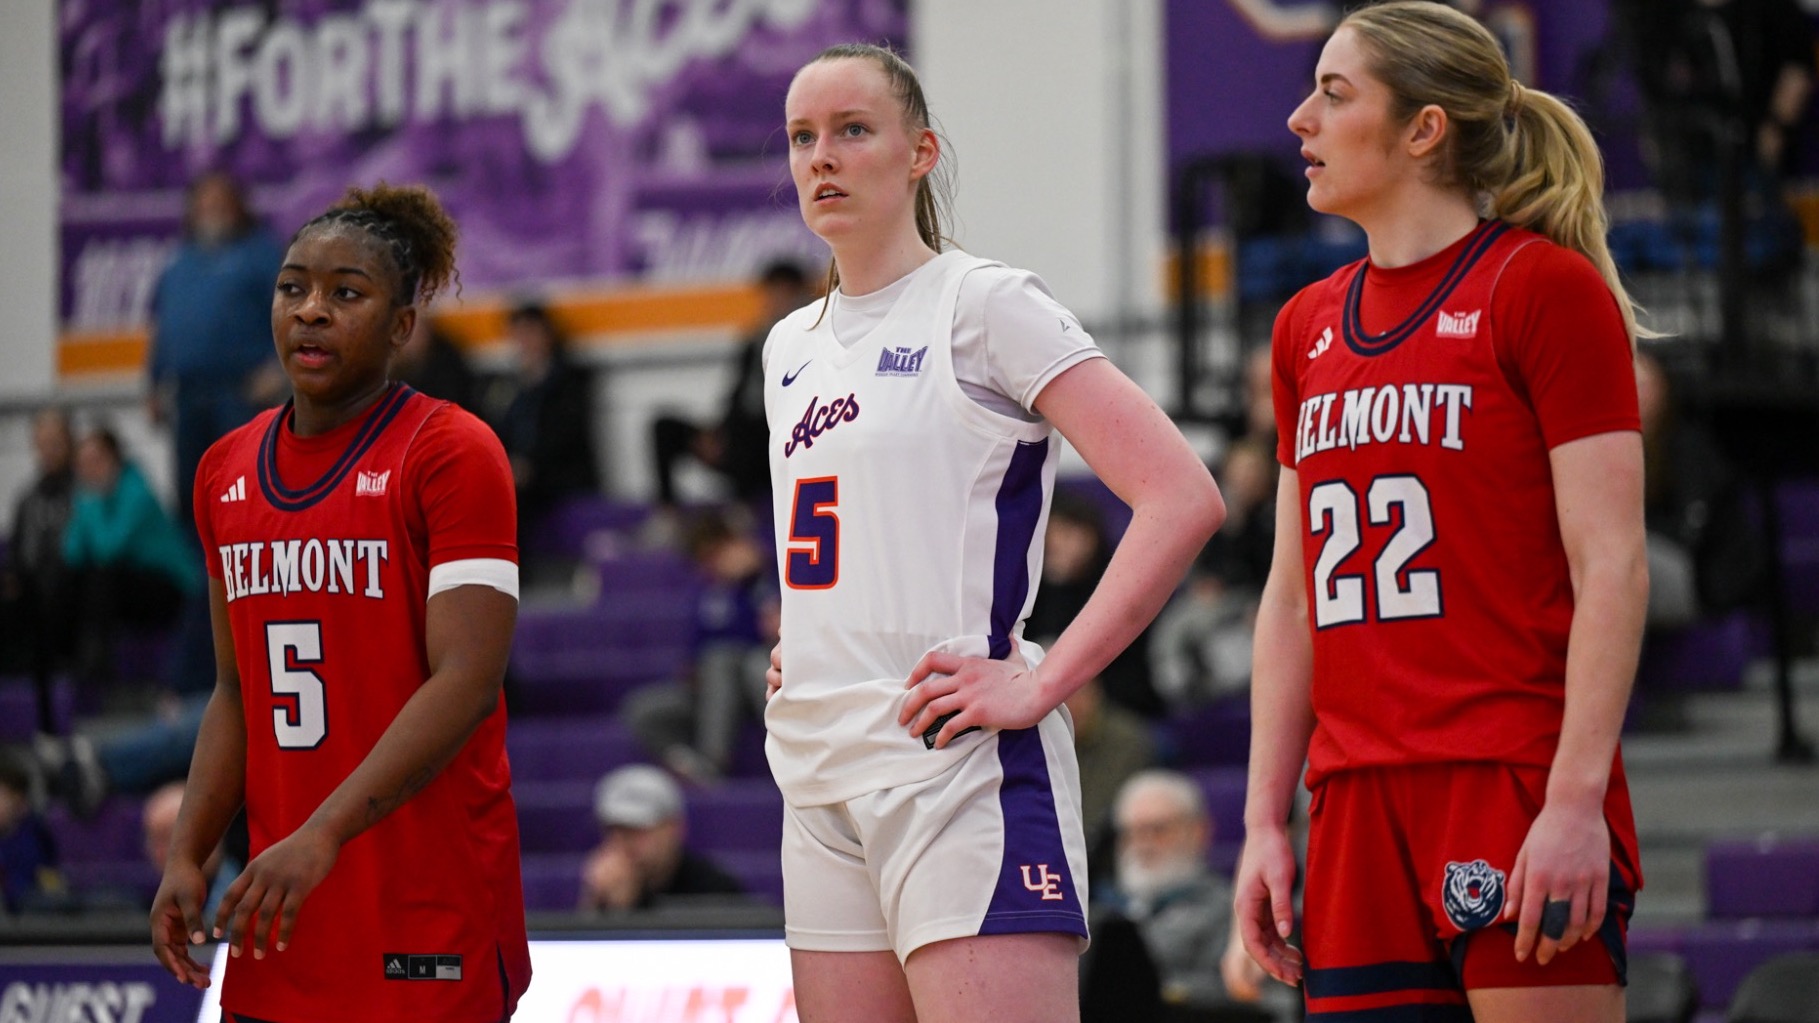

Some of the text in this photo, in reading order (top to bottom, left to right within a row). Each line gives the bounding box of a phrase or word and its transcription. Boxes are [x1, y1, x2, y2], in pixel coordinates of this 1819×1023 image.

[1437, 309, 1482, 334] VALLEY
[877, 345, 928, 372] VALLEY
[896, 346, 912, 354] THE
[784, 392, 860, 459] Aces
[356, 469, 392, 492] VALLEY
[784, 475, 840, 591] 5
[1308, 473, 1444, 632] 22
[218, 537, 389, 603] BELMONT
[264, 620, 329, 751] 5
[1019, 863, 1063, 901] UE
